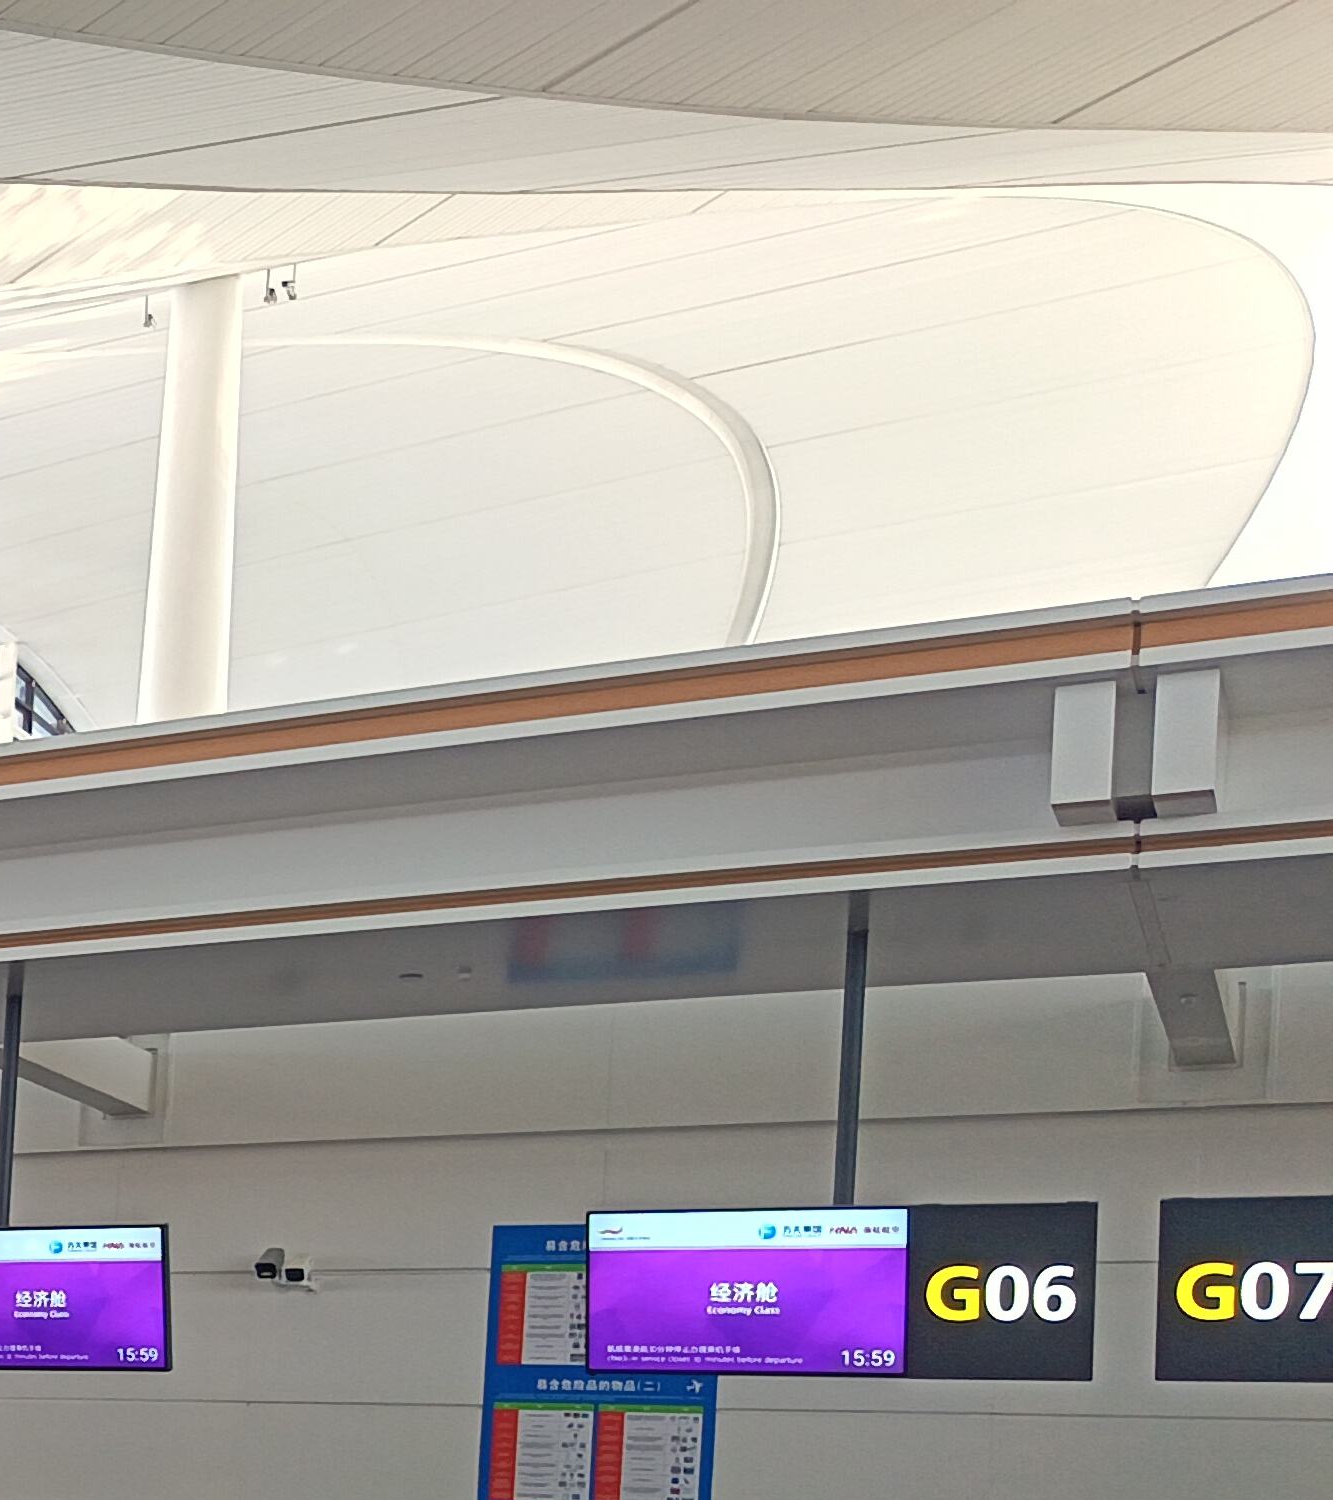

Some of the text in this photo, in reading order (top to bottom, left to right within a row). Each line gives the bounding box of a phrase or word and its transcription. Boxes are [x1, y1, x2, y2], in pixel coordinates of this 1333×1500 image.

[15, 1289, 67, 1308] 经济舱
[709, 1281, 779, 1303] 经济舱
[925, 1264, 1077, 1322] G06
[1176, 1261, 1333, 1321] G07
[707, 1305, 780, 1316] Economy Class
[116, 1347, 159, 1363] 15:59
[840, 1349, 896, 1367] 15:59
